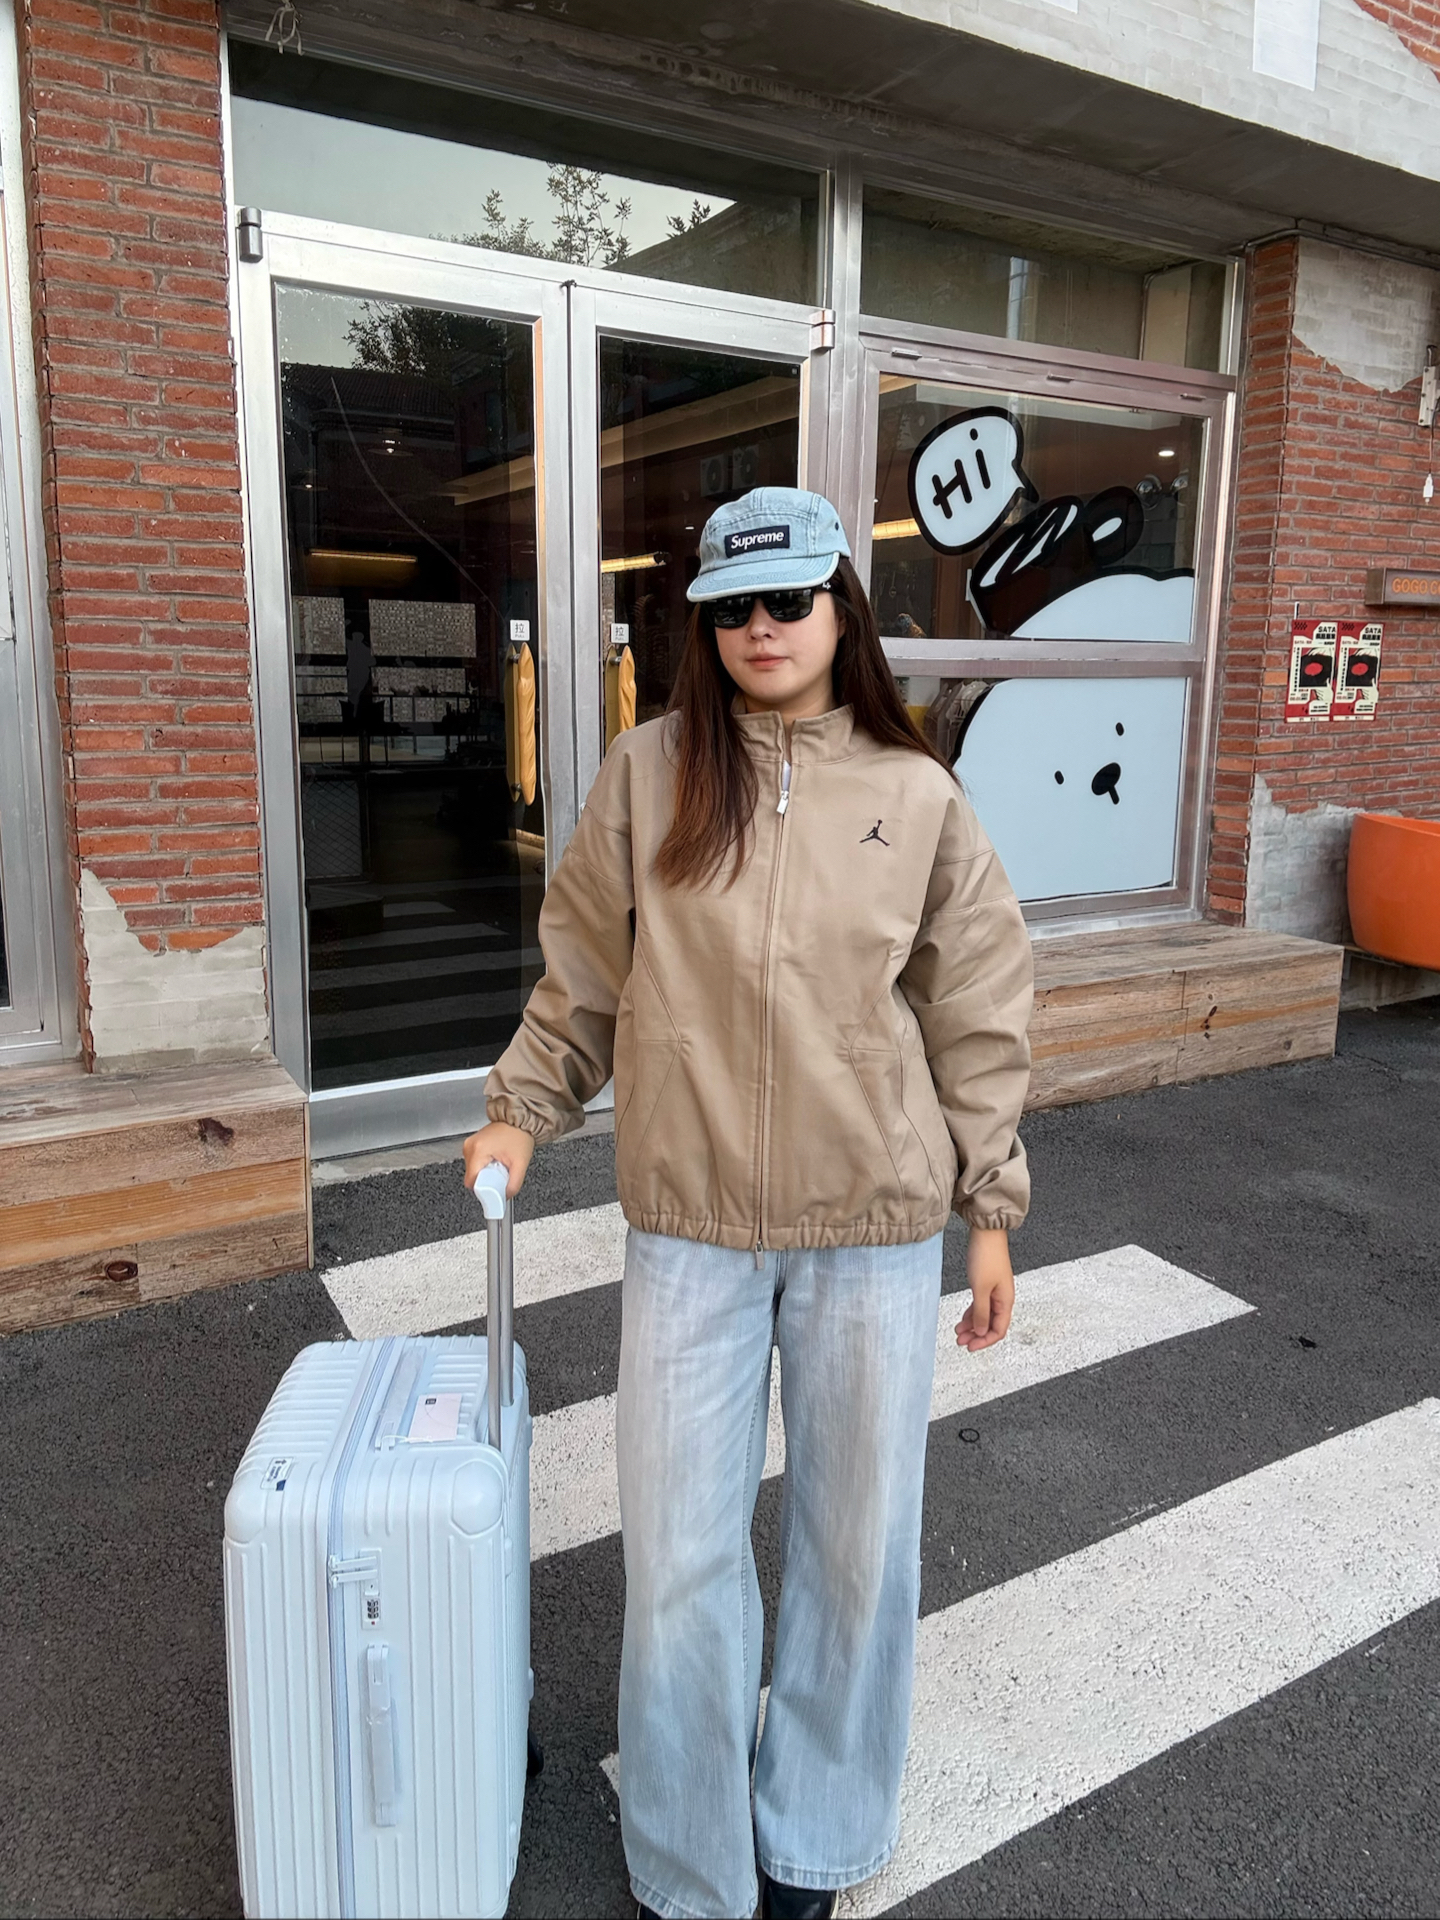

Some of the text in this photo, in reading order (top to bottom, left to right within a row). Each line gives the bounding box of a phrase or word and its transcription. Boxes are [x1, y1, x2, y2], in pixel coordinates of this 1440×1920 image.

[730, 531, 785, 550] Supreme
[1392, 577, 1440, 595] GOGO C
[515, 622, 525, 633] 拉
[615, 626, 625, 636] 拉
